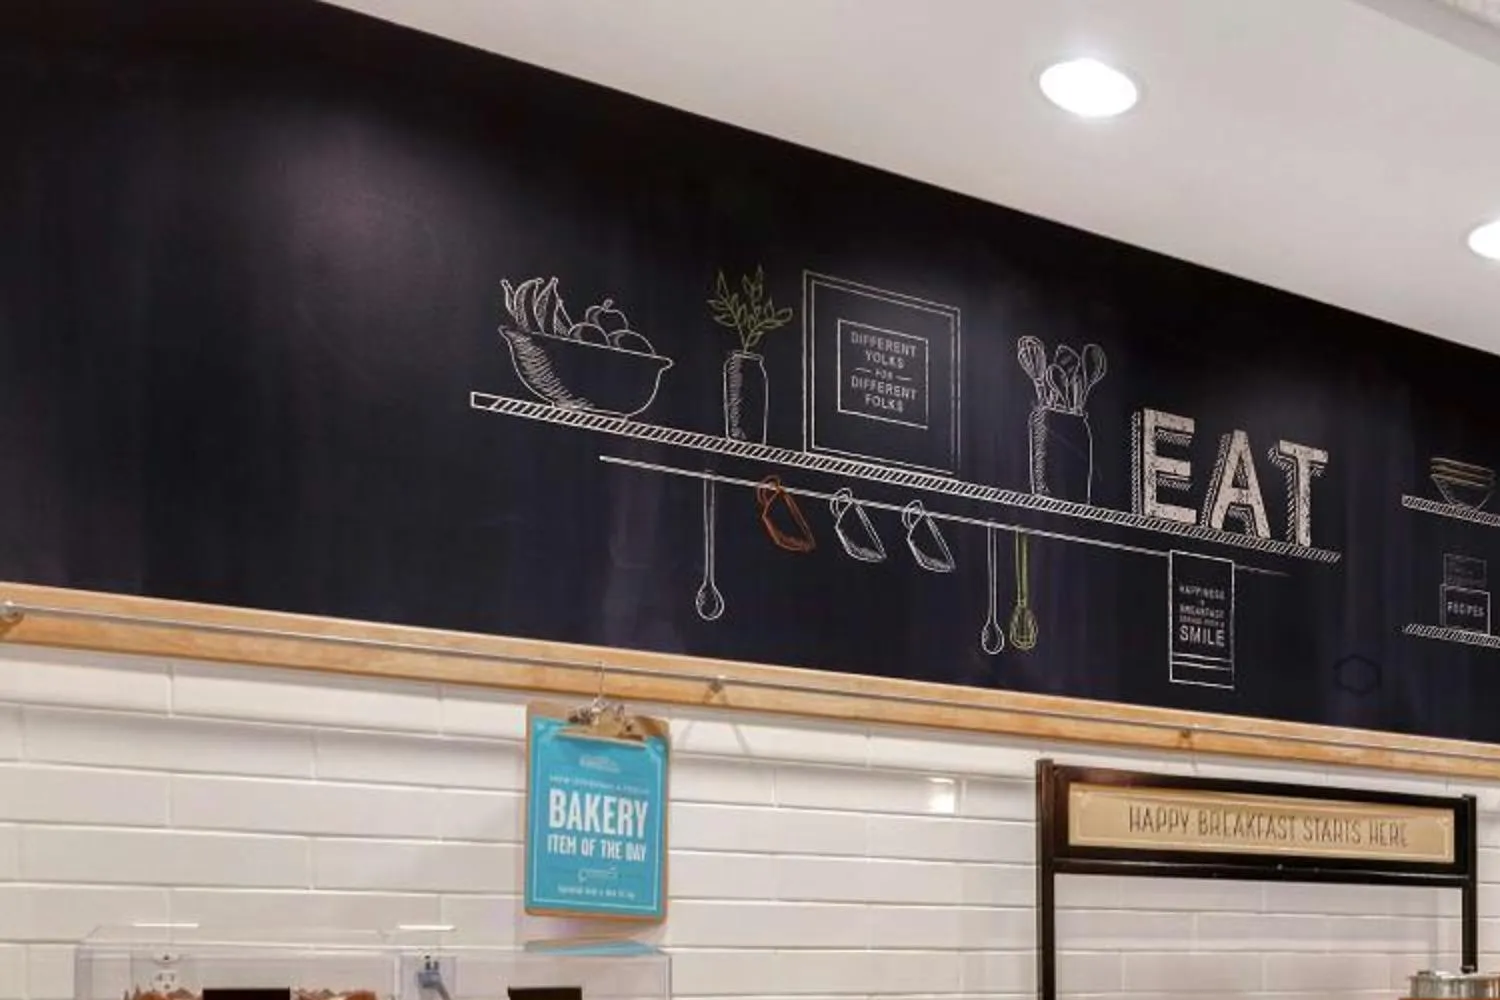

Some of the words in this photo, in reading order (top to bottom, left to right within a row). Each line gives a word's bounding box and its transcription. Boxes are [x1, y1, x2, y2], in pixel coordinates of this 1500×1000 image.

[851, 331, 917, 358] DIFFERENT
[865, 349, 905, 369] YOLKS
[851, 375, 917, 400] DIFFERENT
[865, 393, 903, 413] FOLKS
[1130, 408, 1329, 548] EAT
[1179, 625, 1225, 647] SMILE
[549, 787, 649, 839] BAKERY
[1128, 806, 1190, 834] HAPPY
[1199, 810, 1296, 841] BREAKFAST
[1303, 816, 1362, 845] STARTS
[1369, 821, 1409, 848] HERE
[547, 834, 577, 856] ITEM
[581, 838, 596, 857] OF
[601, 840, 623, 861] THE
[625, 842, 648, 862] DAY
